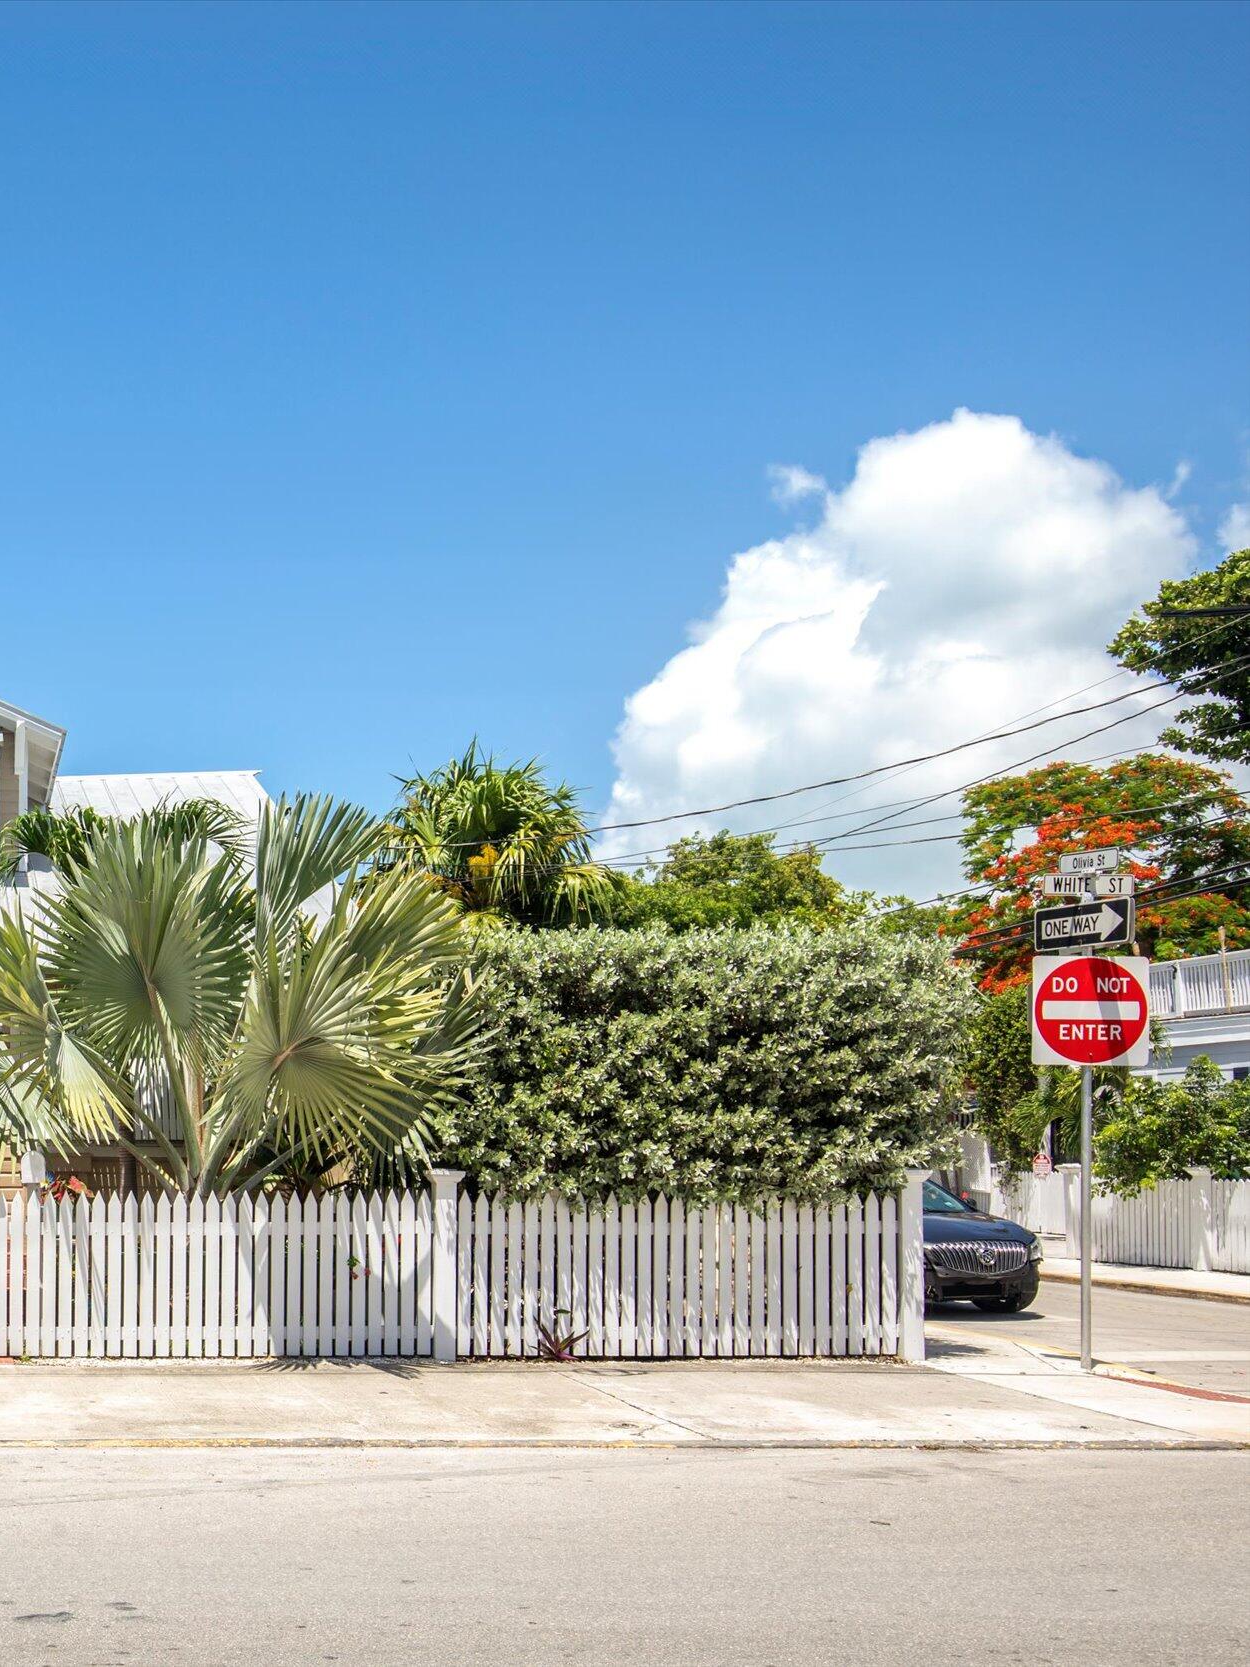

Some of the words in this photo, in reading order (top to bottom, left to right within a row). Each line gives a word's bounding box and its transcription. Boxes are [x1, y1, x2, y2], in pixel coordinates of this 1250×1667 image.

[1072, 857, 1094, 869] Olivia
[1097, 854, 1106, 866] St
[1053, 877, 1091, 893] WHITE
[1108, 877, 1124, 893] ST
[1044, 919, 1069, 937] ONE
[1072, 915, 1099, 933] WAY
[1052, 976, 1079, 993] DO
[1096, 976, 1131, 993] NOT
[1059, 1023, 1122, 1041] ENTER
